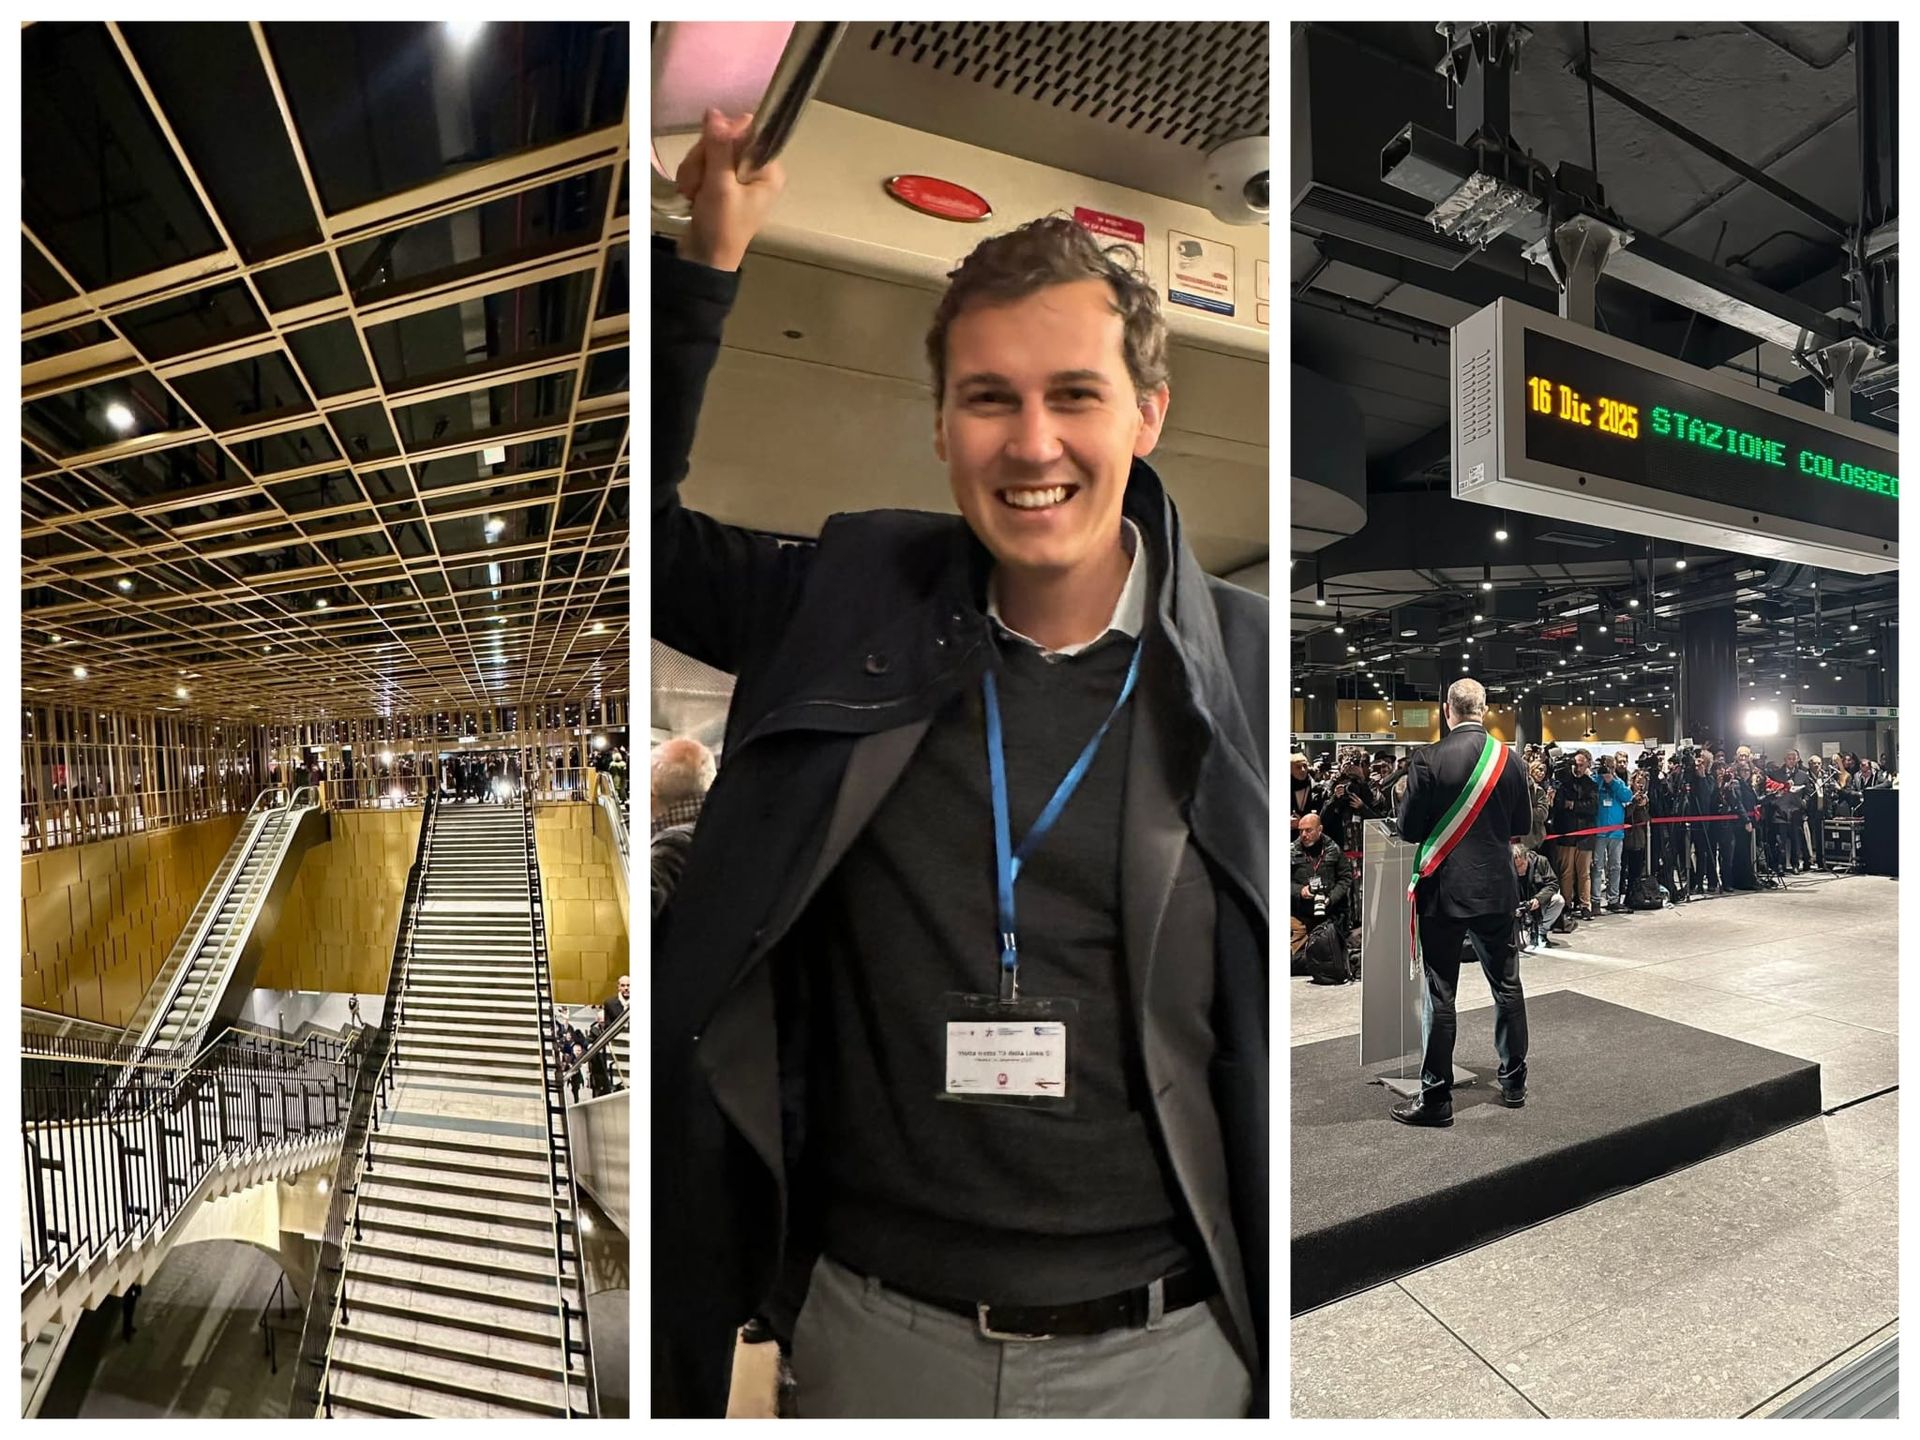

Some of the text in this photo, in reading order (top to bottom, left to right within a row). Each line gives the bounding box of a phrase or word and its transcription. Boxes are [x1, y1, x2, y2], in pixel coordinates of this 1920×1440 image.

[1528, 376, 1638, 438] 16 Dic 2025
[1651, 406, 1786, 466] STAZIONE
